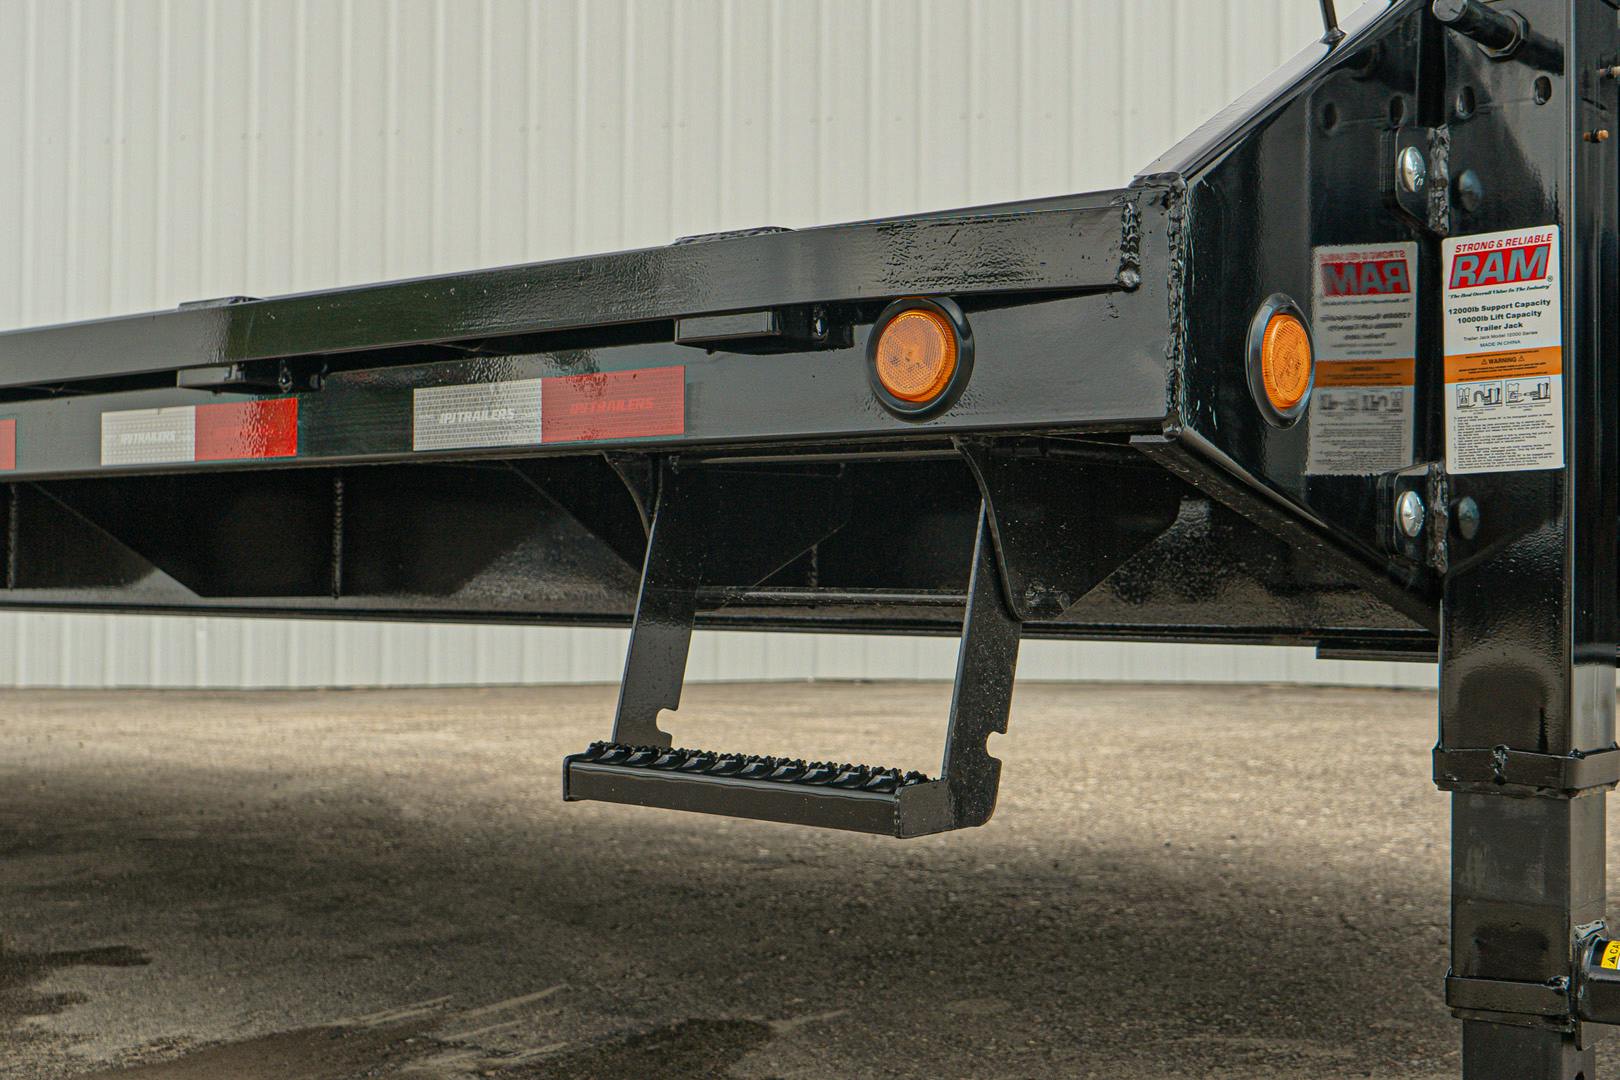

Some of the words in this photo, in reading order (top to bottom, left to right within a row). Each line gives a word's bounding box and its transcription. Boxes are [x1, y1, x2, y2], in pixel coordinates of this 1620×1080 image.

[1455, 240, 1494, 253] STRONG
[1496, 239, 1503, 248] &
[1505, 233, 1553, 247] RELIABLE
[1451, 245, 1549, 288] RAM
[1448, 306, 1479, 315] 12000lb
[1481, 303, 1513, 312] Support
[1514, 299, 1551, 308] Capacity
[1457, 315, 1489, 324] 10000lb
[1505, 310, 1542, 319] Capacity
[1504, 322, 1523, 330] Jack
[1488, 357, 1517, 365] WARNING
